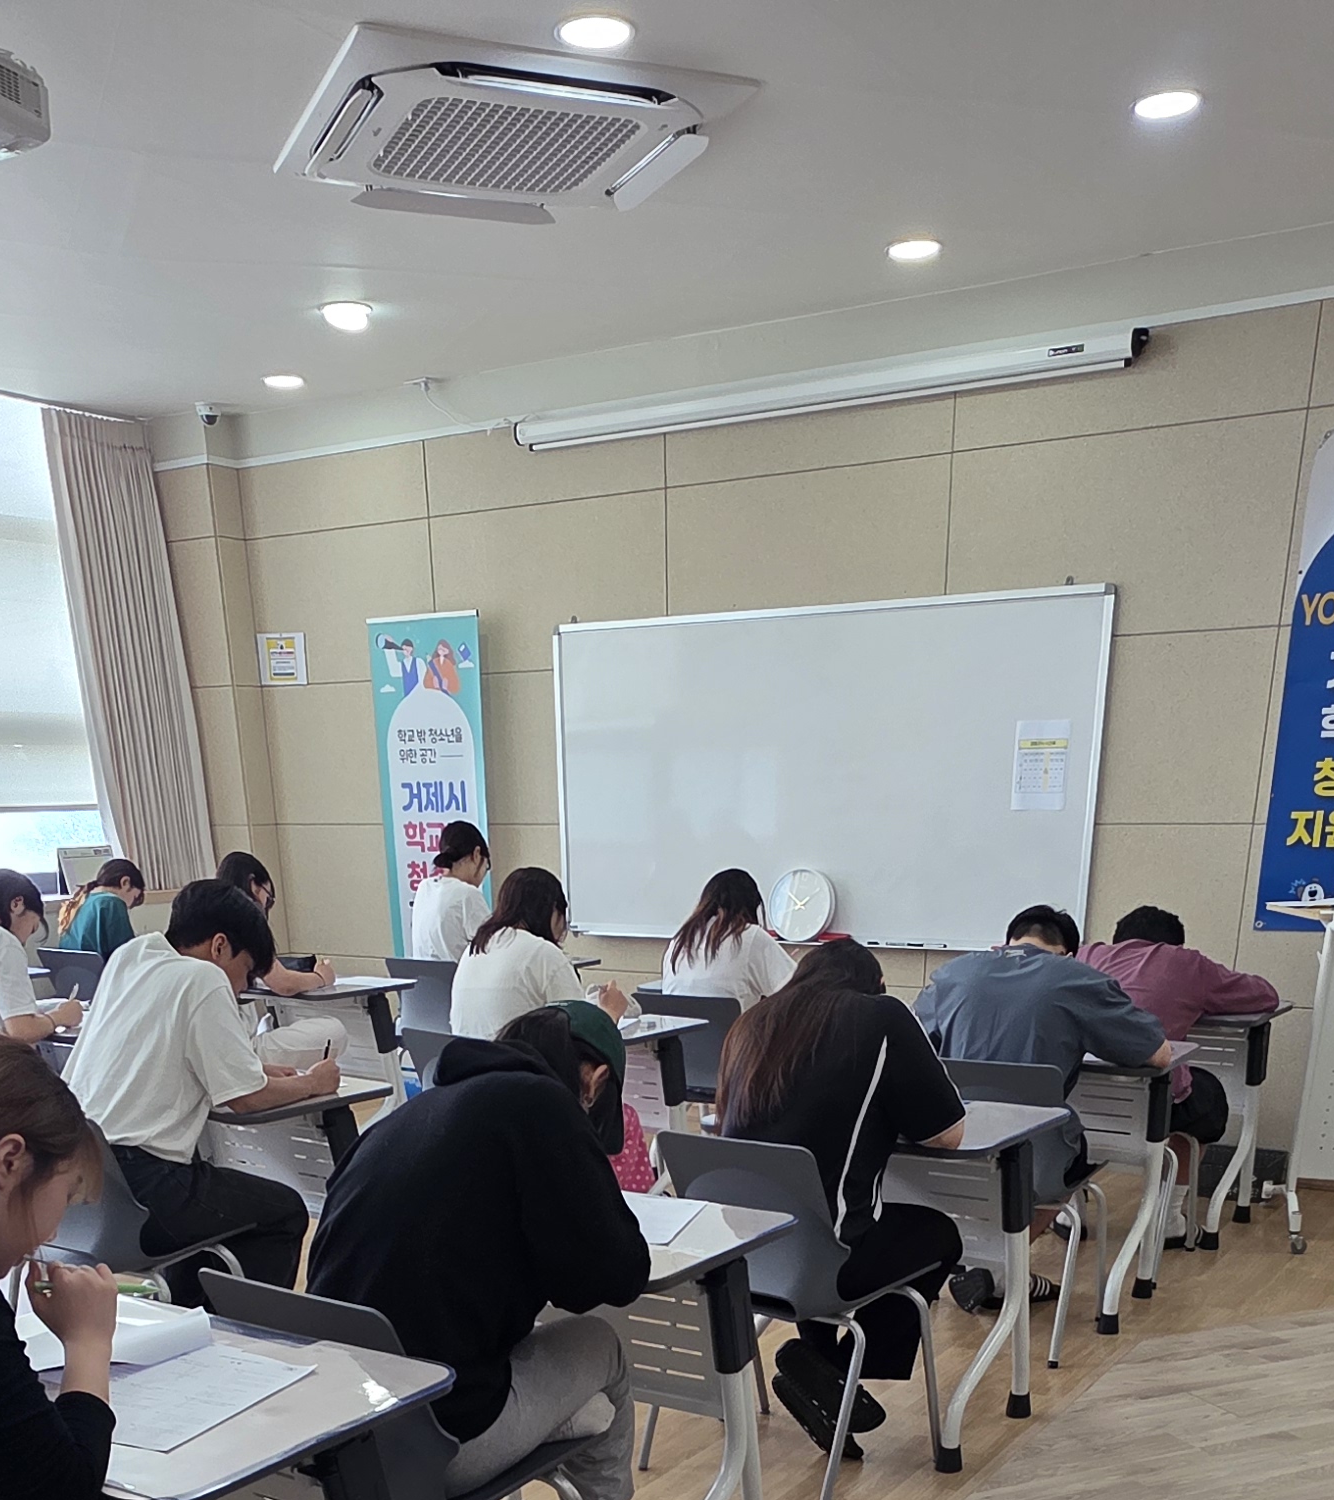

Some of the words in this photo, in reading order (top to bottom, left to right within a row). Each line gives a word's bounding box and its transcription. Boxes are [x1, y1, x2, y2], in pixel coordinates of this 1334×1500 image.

[397, 728, 415, 744] 학교
[416, 728, 426, 744] 밖
[428, 726, 463, 744] 청소년을
[399, 748, 417, 764] 위한
[419, 748, 437, 764] 공간
[401, 780, 467, 813] 거제시
[403, 821, 444, 853] 학교
